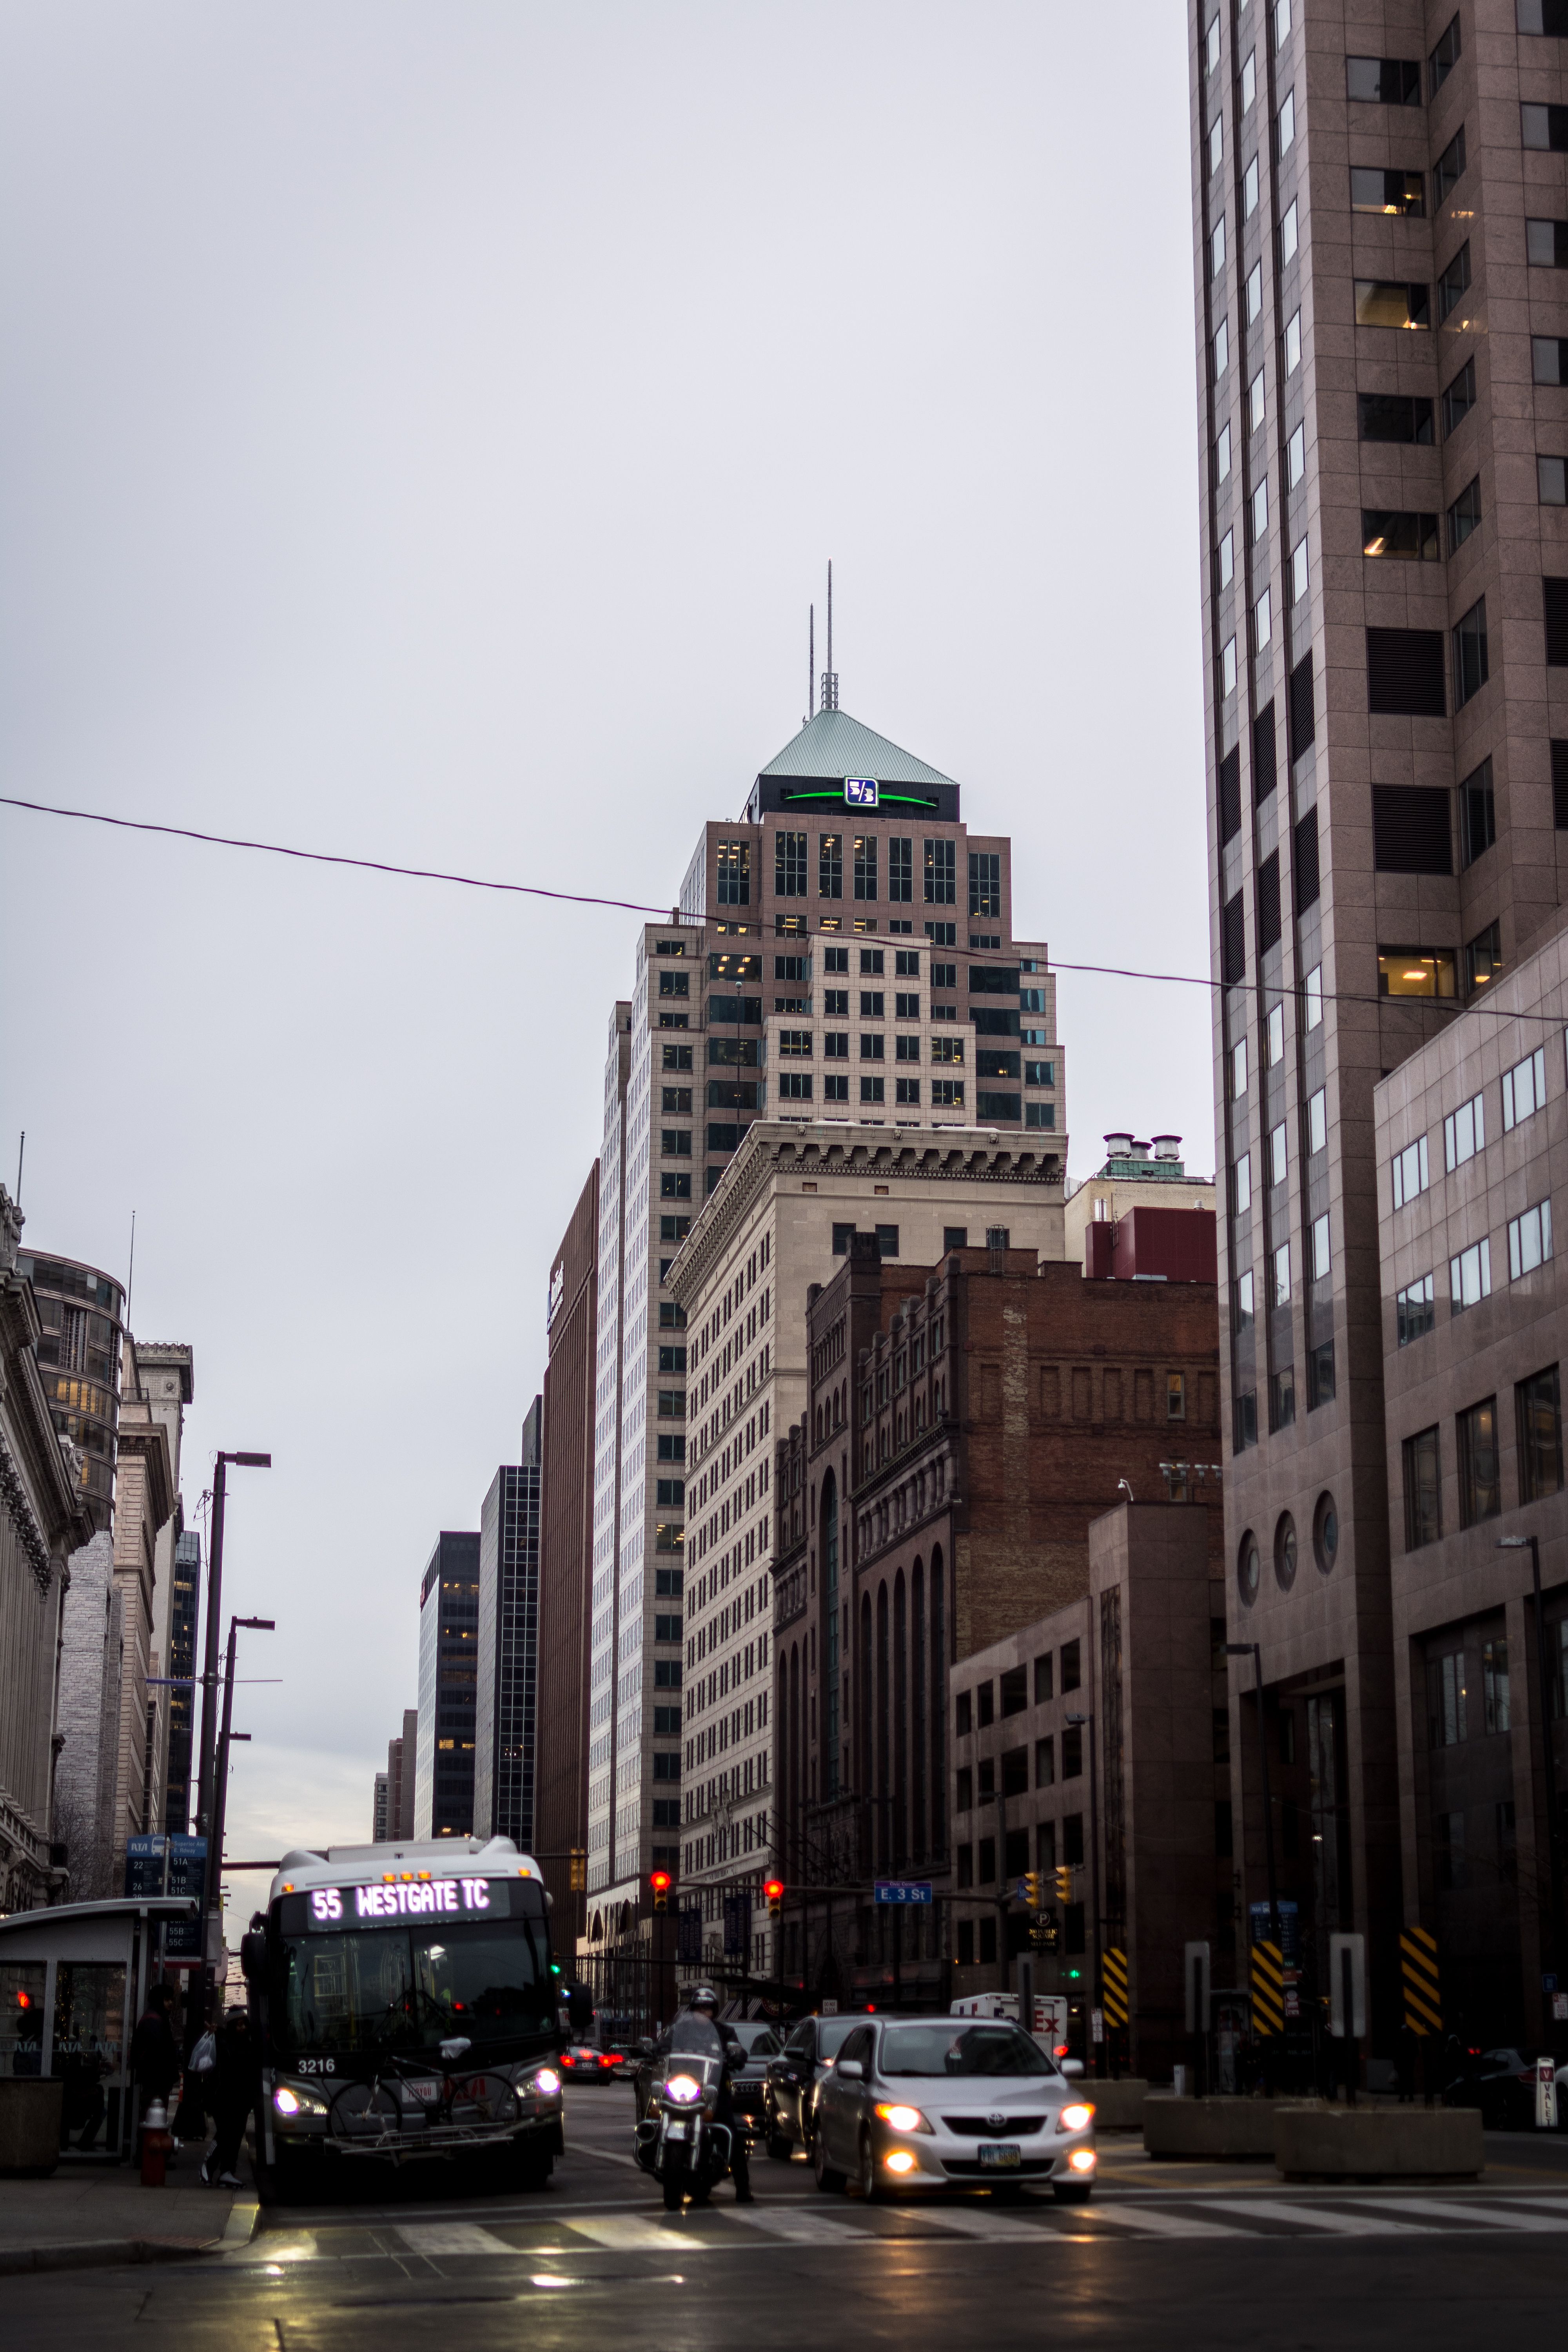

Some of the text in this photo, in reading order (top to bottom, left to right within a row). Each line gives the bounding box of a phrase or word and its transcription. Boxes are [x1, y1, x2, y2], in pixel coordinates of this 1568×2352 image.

[313, 1878, 490, 1920] 55 WESTGATE TC
[881, 1888, 925, 1900] E. 3 St
[1040, 1913, 1047, 1924] P
[299, 2058, 335, 2074] 3216
[1543, 2070, 1550, 2079] V
